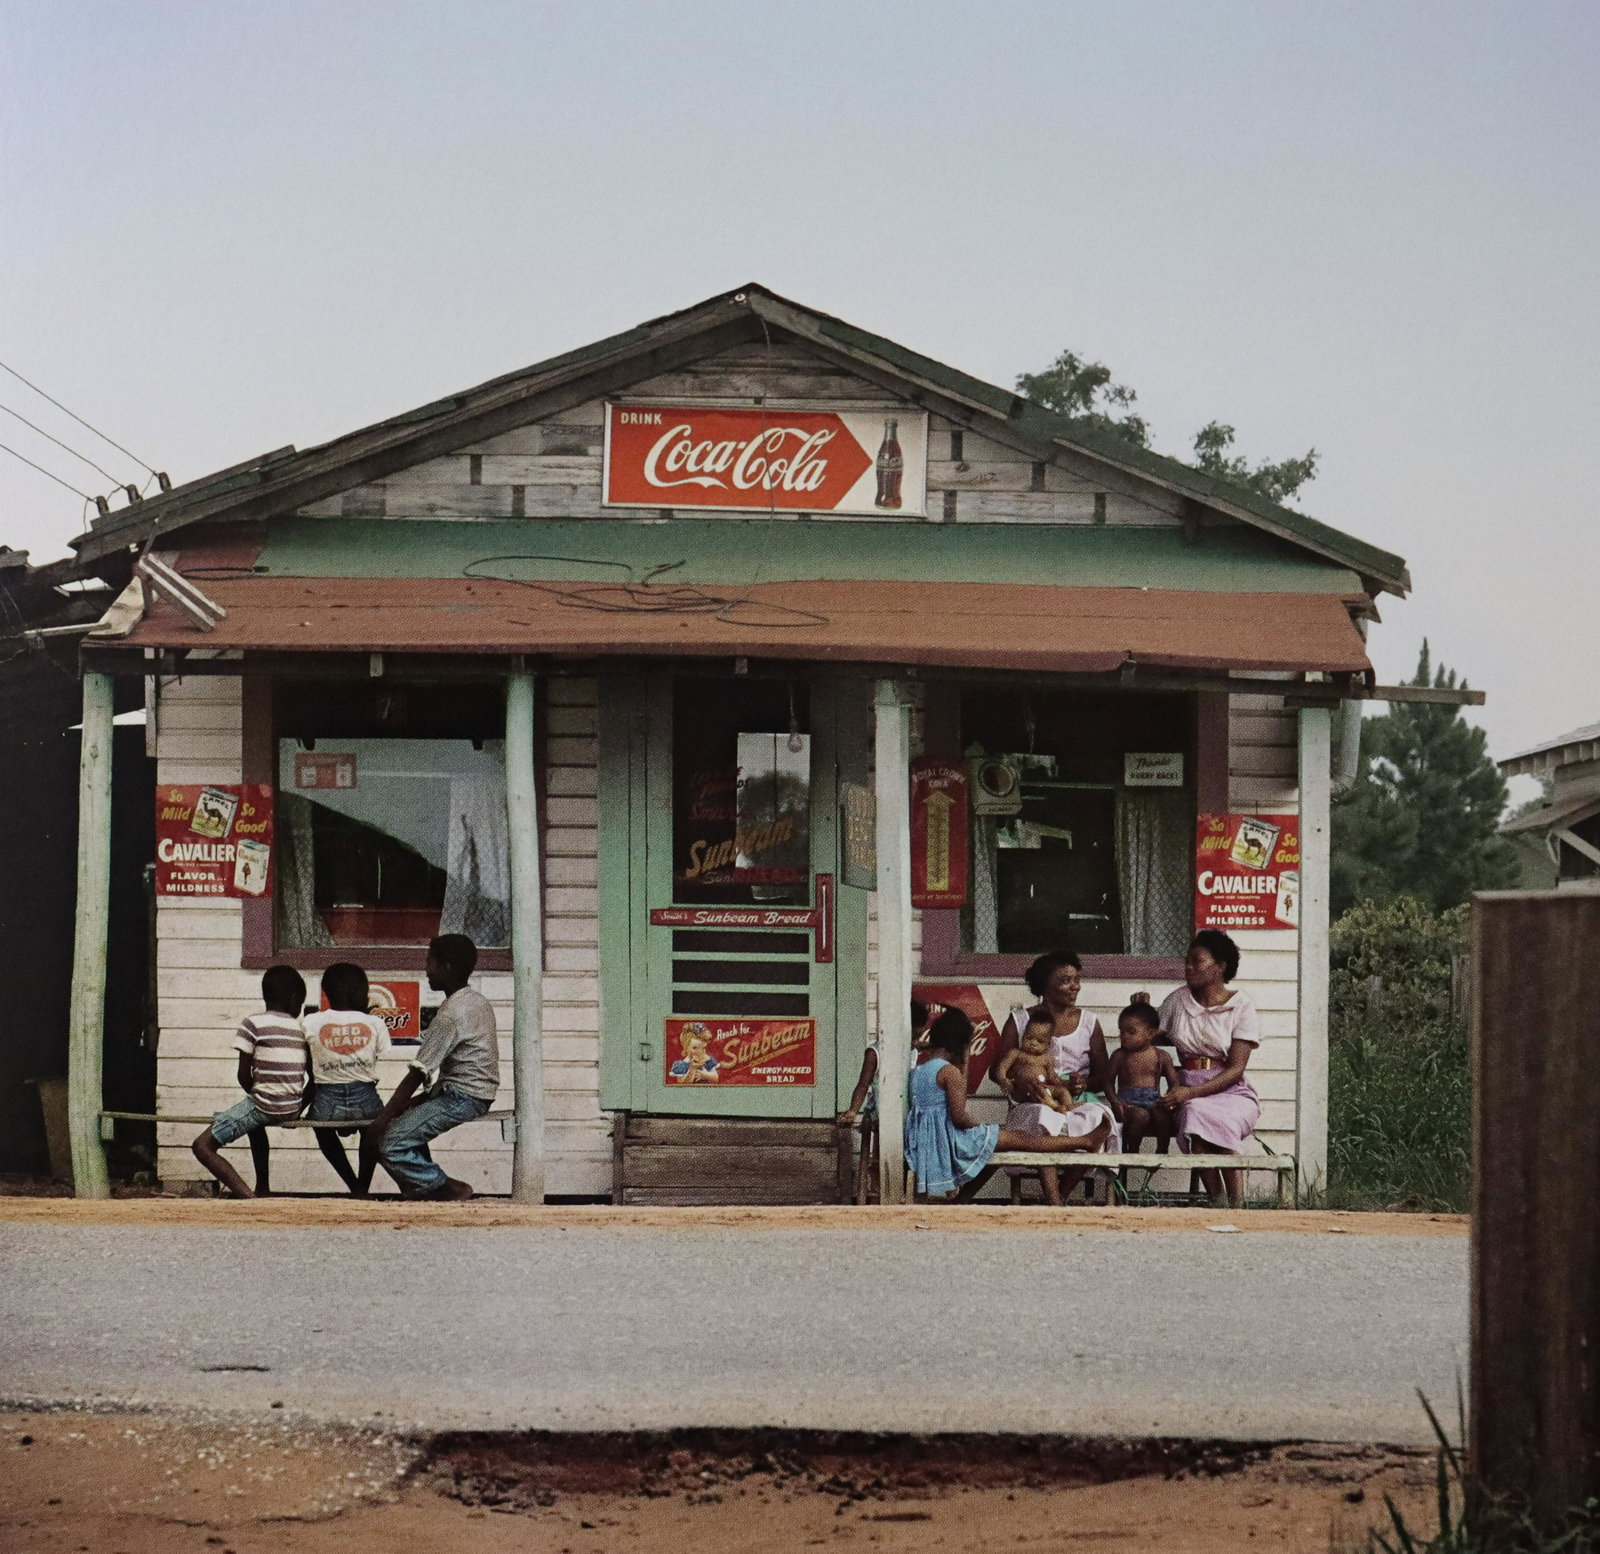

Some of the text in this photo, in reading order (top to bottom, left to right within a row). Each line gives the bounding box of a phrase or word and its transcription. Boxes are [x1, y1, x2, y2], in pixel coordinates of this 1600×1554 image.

[620, 411, 663, 425] DRINK
[643, 424, 839, 492] Coca-Cola
[169, 789, 183, 802] So
[162, 807, 191, 820] Mild
[241, 803, 255, 816] So
[235, 820, 267, 833] Good
[1210, 819, 1224, 832] So
[1202, 837, 1232, 849] Mild
[1282, 833, 1297, 846] So
[158, 838, 236, 863] CAVALIER
[1276, 850, 1300, 863] Goo
[166, 883, 225, 893] MILDNESS
[1197, 870, 1278, 895] CAVALIER
[694, 910, 759, 925] Sunbeam
[763, 911, 811, 925] Bread
[1205, 916, 1266, 926] MILDNESS
[382, 1012, 411, 1029] est
[331, 1026, 362, 1036] RED
[716, 1024, 738, 1041] Reach
[323, 1036, 369, 1048] HEART
[720, 1023, 811, 1069] Sunbeam
[766, 1075, 795, 1083] BREAD
